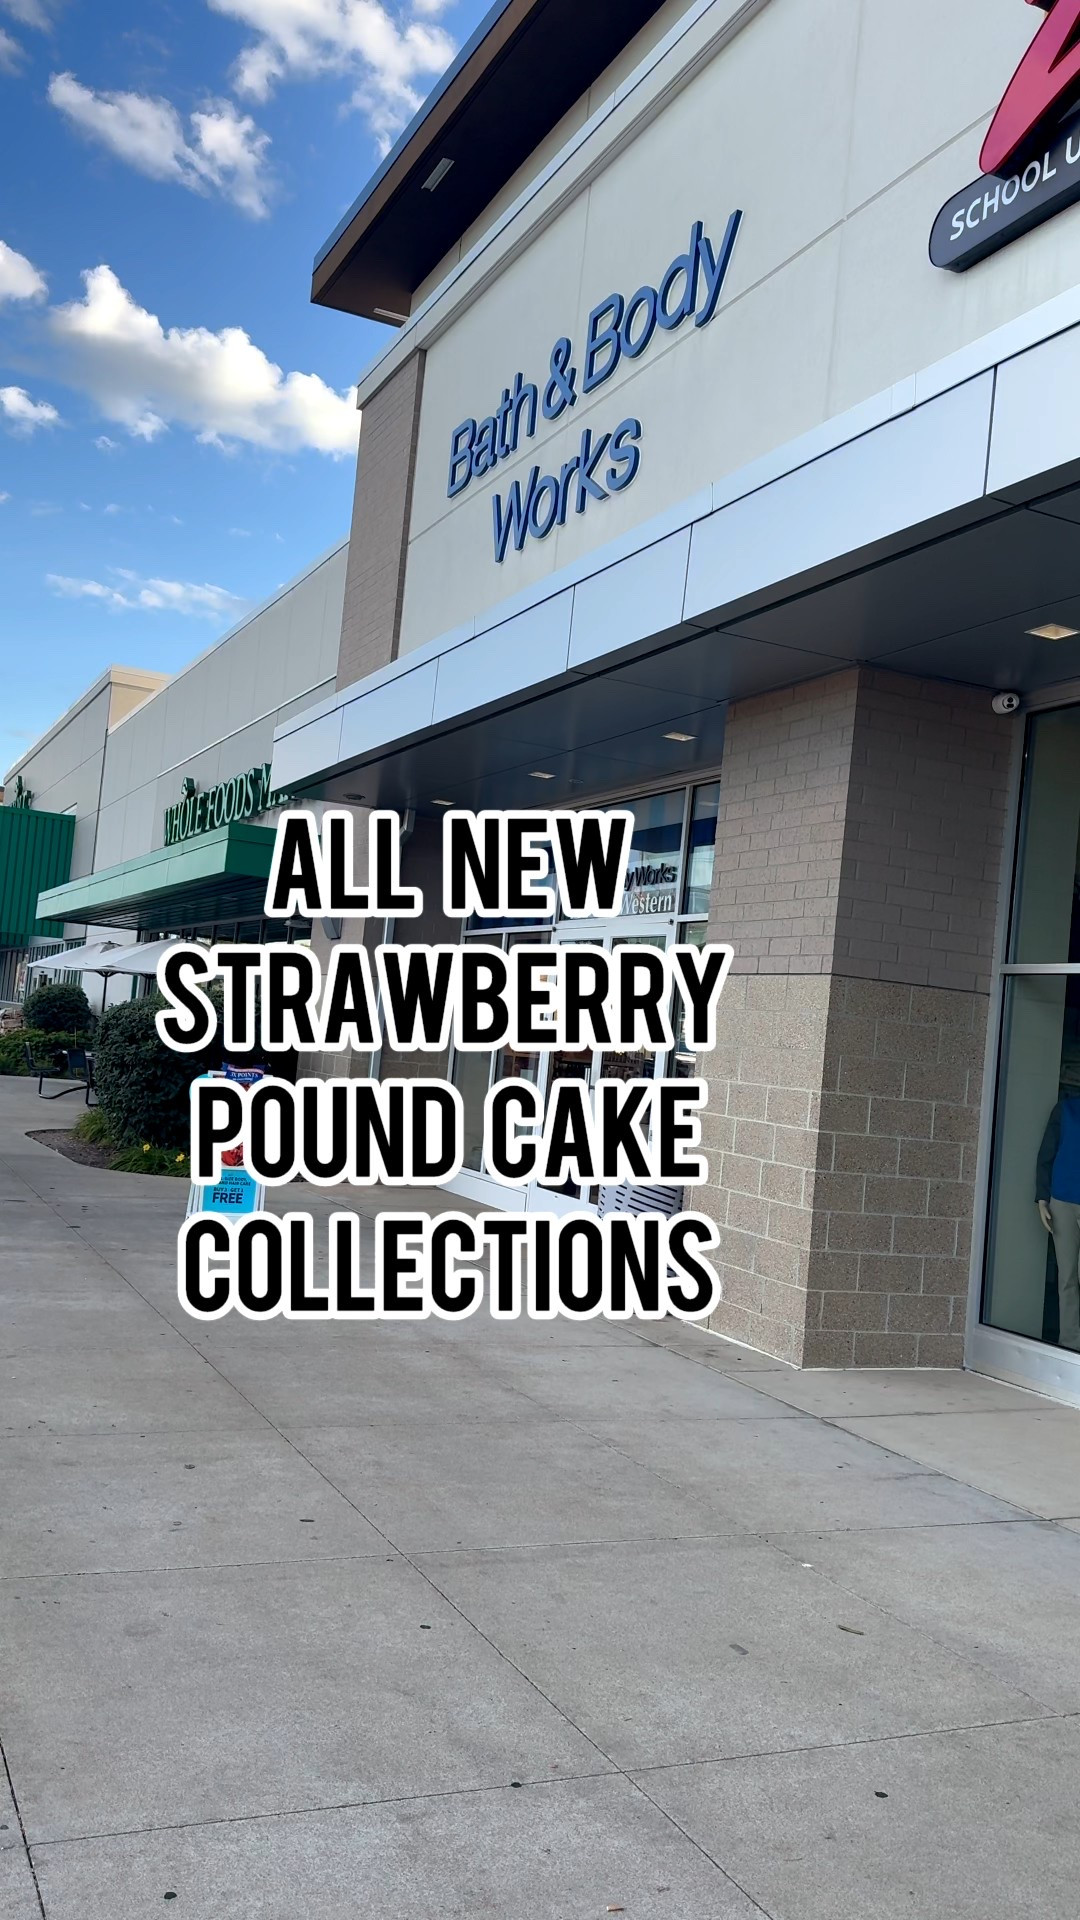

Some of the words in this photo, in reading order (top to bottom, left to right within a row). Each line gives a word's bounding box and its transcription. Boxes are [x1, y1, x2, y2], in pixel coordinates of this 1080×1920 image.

[949, 151, 1057, 241] SCHOOL
[446, 371, 538, 499] Bath
[542, 336, 577, 421] &
[582, 209, 744, 395] Body
[491, 417, 643, 564] Works
[164, 791, 206, 846] WHOLE
[205, 767, 260, 831] FOODS
[634, 862, 678, 887] Works
[212, 1192, 243, 1204] FREE
